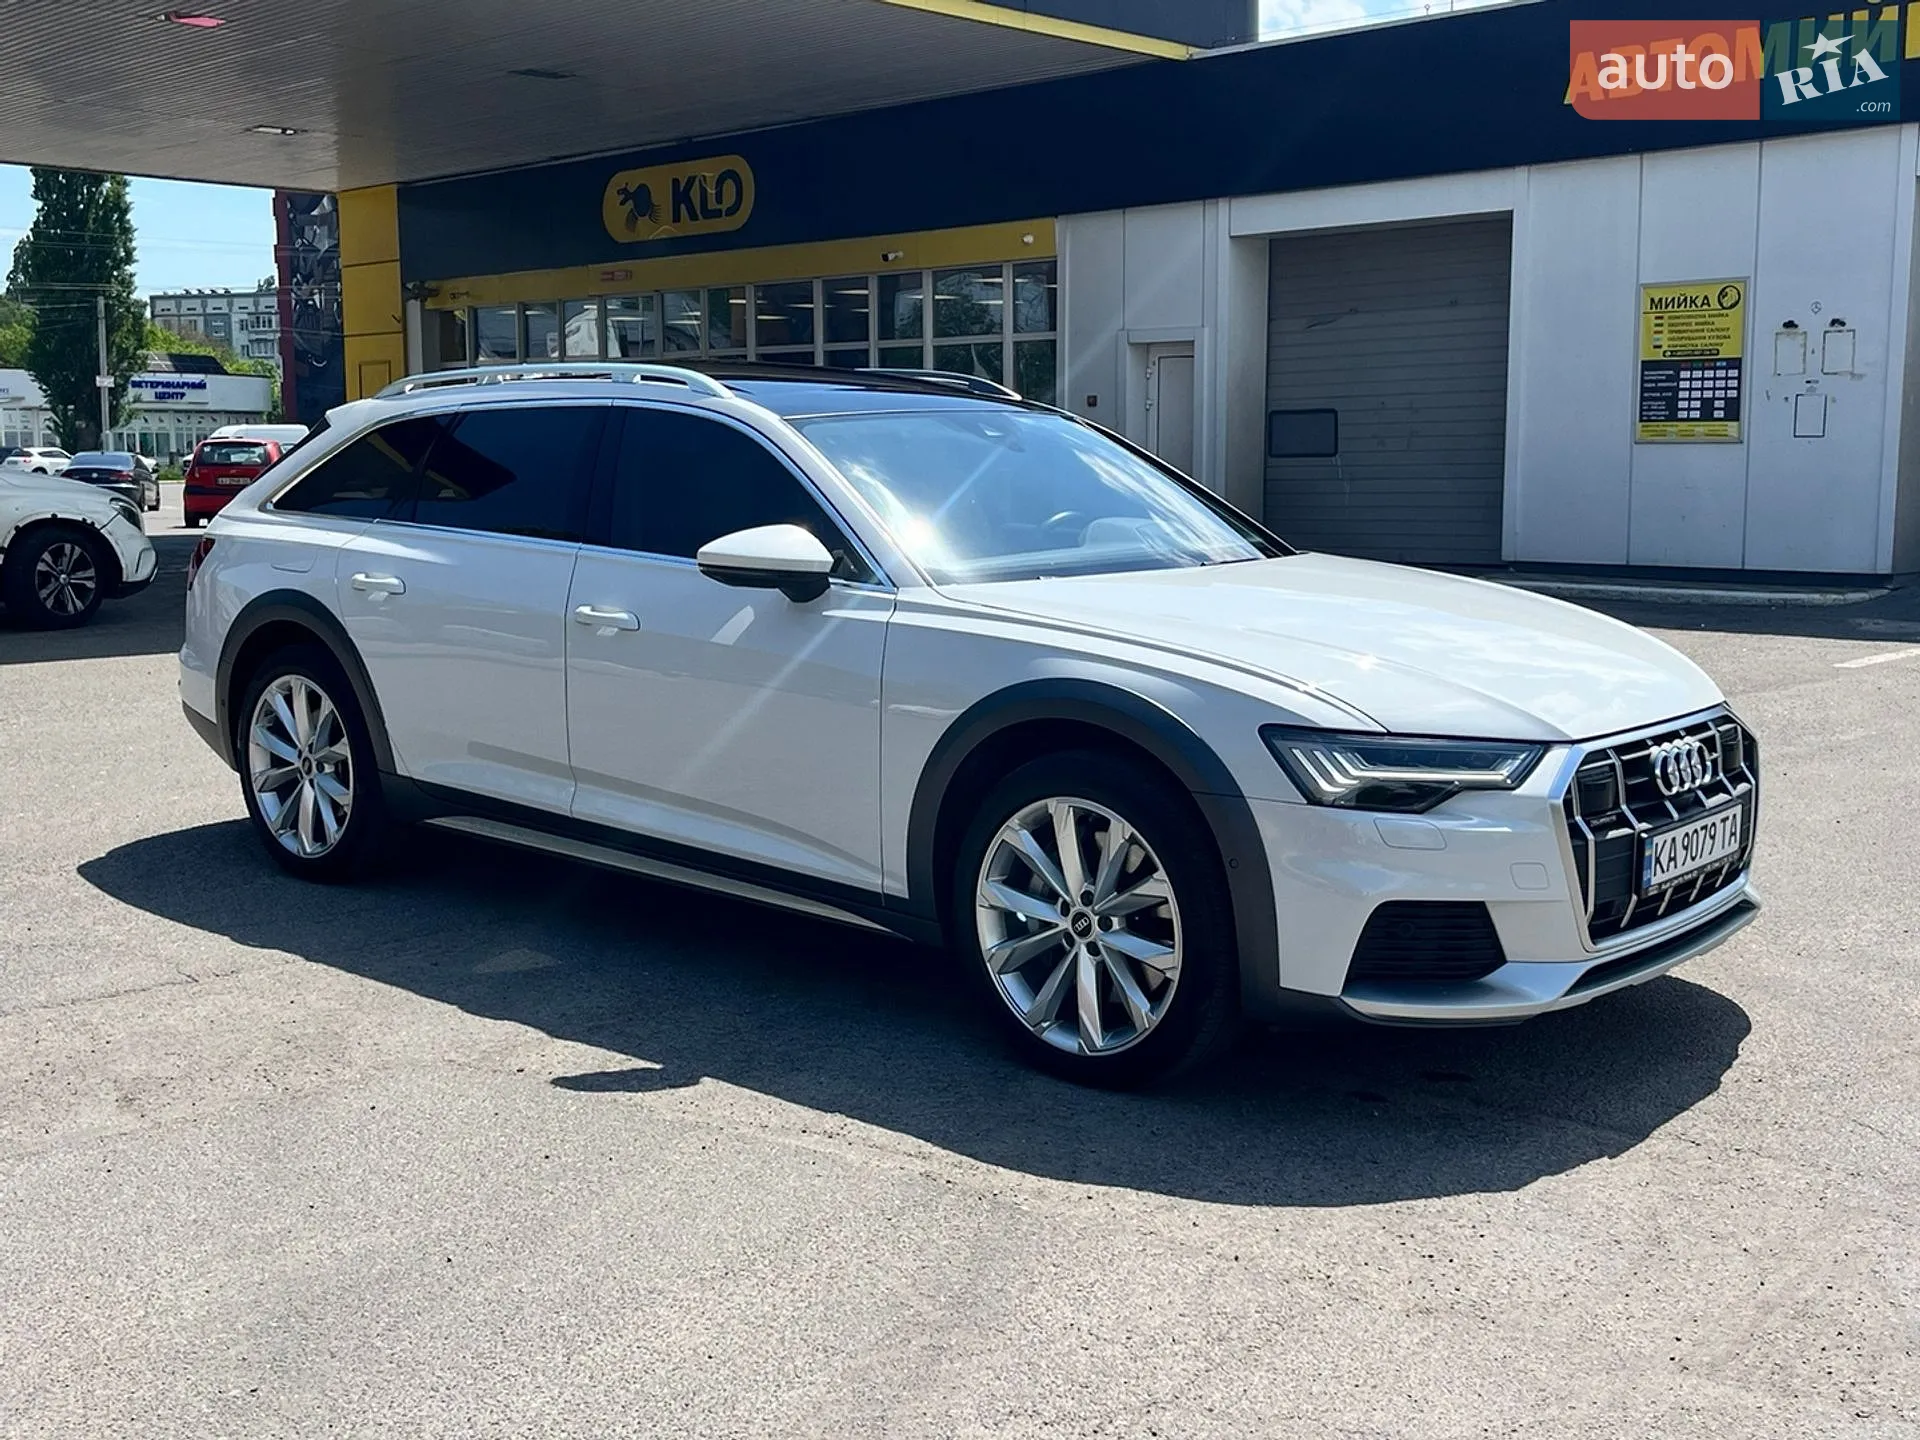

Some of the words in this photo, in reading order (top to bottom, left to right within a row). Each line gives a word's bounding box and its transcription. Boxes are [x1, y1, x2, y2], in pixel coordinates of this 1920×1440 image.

[672, 169, 743, 223] KLO
[1649, 292, 1711, 310] МИЙКА
[1653, 837, 1677, 877] KA
[1681, 822, 1717, 866] 9079
[1720, 813, 1737, 850] TA
